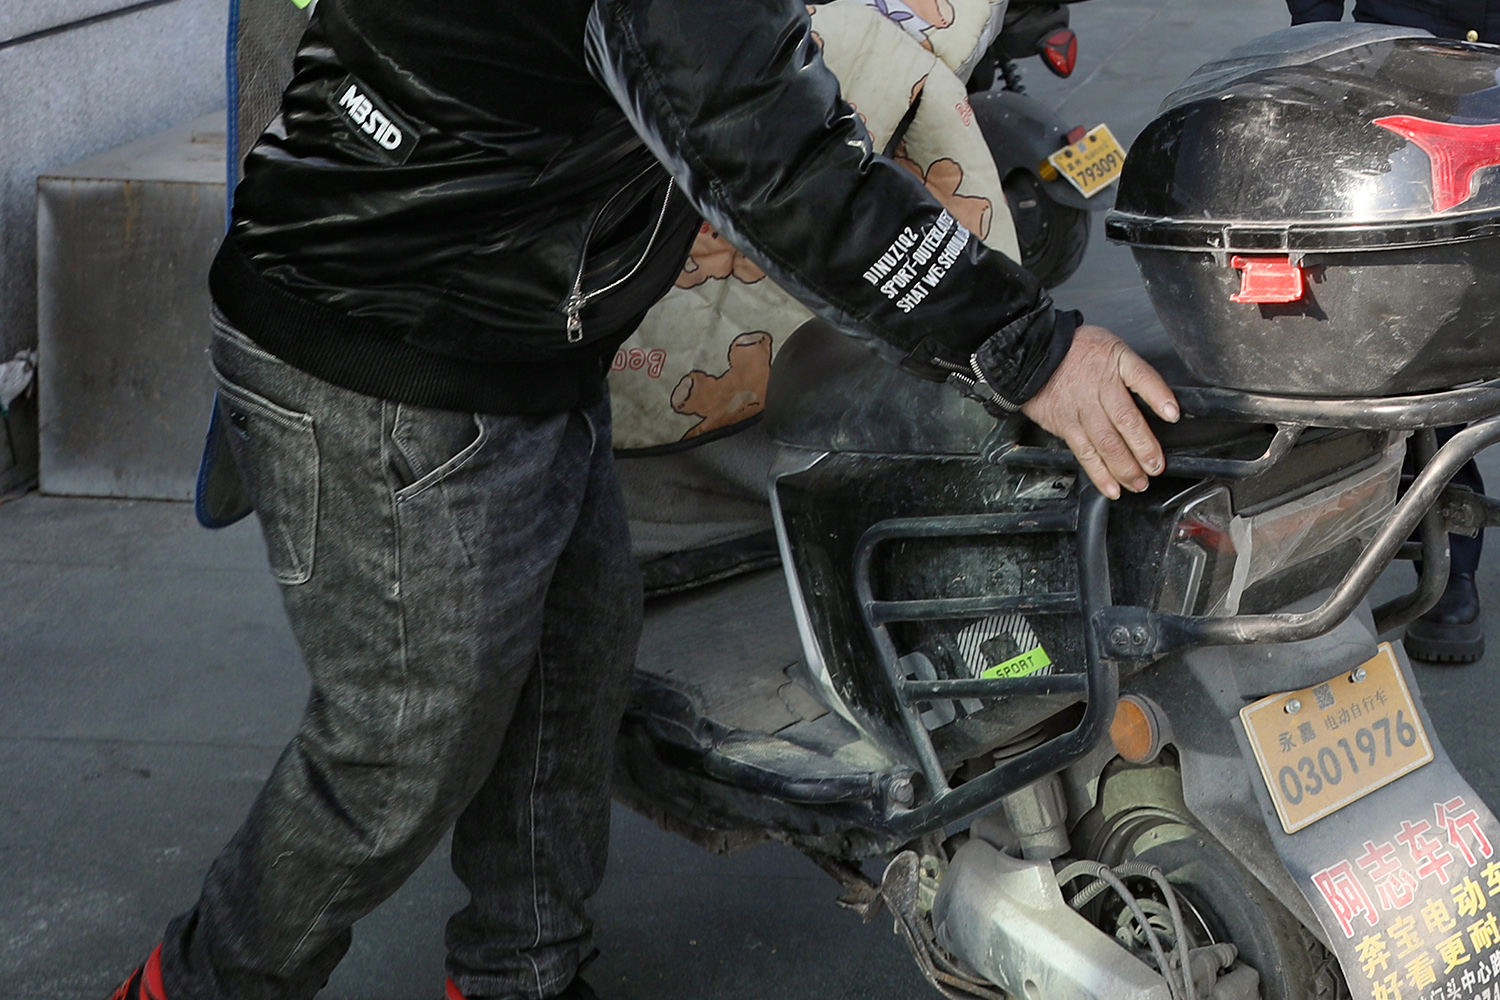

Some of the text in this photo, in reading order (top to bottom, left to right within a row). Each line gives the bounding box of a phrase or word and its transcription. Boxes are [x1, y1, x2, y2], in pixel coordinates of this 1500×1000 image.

[921, 263, 947, 289] WE
[995, 655, 1036, 679] SPORT
[1278, 687, 1388, 753] 永嘉 电动自行车
[1278, 709, 1417, 806] 0301976
[1310, 795, 1495, 939] 阿志车行
